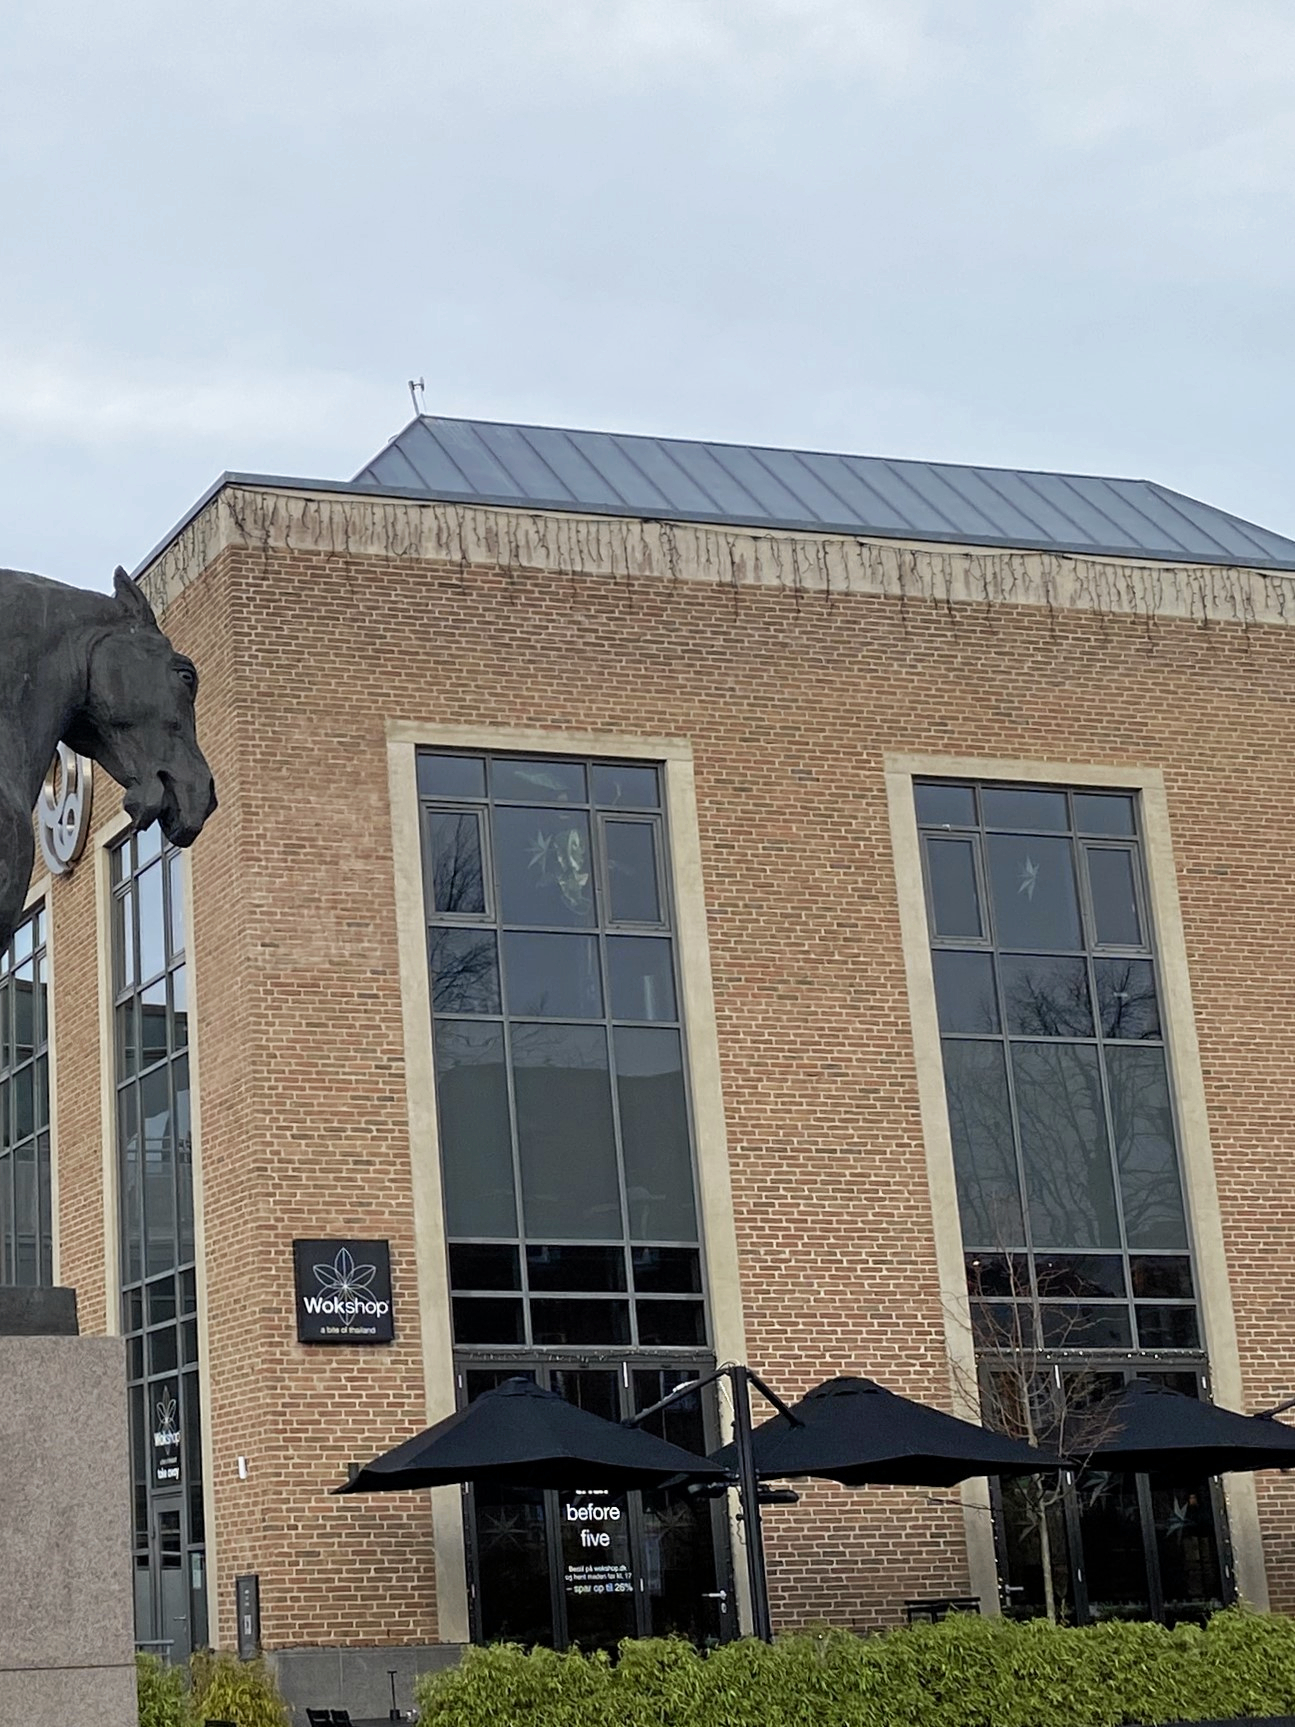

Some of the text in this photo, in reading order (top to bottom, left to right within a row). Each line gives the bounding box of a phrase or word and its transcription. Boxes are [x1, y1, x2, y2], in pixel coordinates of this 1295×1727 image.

[303, 1296, 389, 1318] Wokshop
[566, 1503, 620, 1520] before
[580, 1529, 610, 1547] five
[574, 1585, 592, 1594] spar
[593, 1584, 604, 1594] op
